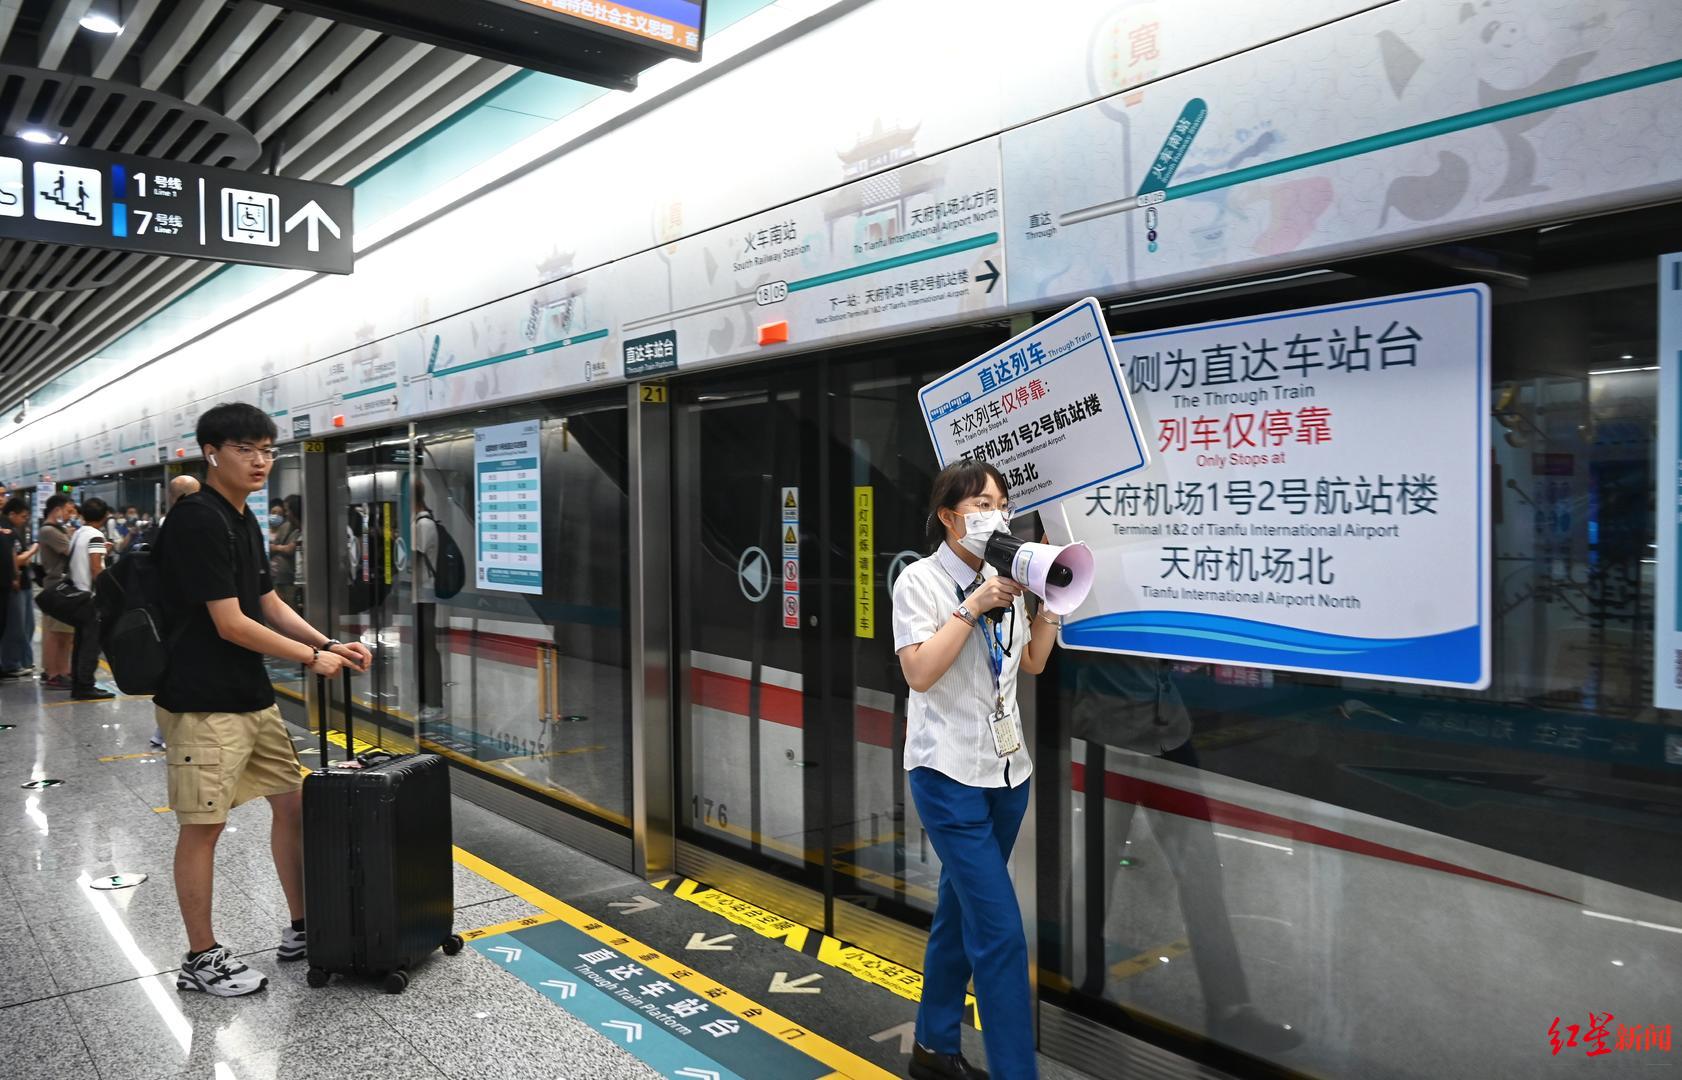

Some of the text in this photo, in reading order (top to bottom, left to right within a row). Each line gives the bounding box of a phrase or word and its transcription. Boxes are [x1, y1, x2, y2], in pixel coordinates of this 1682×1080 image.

[911, 188, 998, 226] 天府机场北方向
[941, 216, 972, 232] Airport
[973, 208, 999, 222] North
[1029, 211, 1051, 229] 直达
[744, 219, 797, 253] 火车南站
[1025, 227, 1057, 240] Through
[733, 244, 810, 272] South Railway Station
[865, 268, 969, 304] 天府机场1号2号航站楼
[625, 339, 674, 364] 直达车站台
[977, 331, 1092, 392] 直达列车 Through Train
[1119, 320, 1423, 395] 侧为直达车站台
[644, 386, 663, 401] 21
[1173, 384, 1315, 409] The Through Train
[960, 393, 1103, 465] 天府机场1号2号航站楼
[965, 431, 977, 442] Train
[976, 427, 988, 439] Only
[988, 421, 1001, 432] Stops
[1158, 405, 1332, 453] 列车仅停靠
[307, 442, 322, 452] 20
[1001, 453, 1017, 467] Tianfu
[1016, 442, 1049, 460] International
[1048, 434, 1067, 447] Airport
[1196, 452, 1286, 470] Only Stops at
[1021, 483, 1039, 496] Airport
[1038, 479, 1053, 490] North
[1085, 473, 1438, 517] 天府机场1号2号航站楼
[1112, 523, 1400, 539] Terminal 1&2 of Tianfu International Airport
[1160, 546, 1335, 586] 天府机场北
[1142, 585, 1361, 609] Tianfu International Airport North
[692, 794, 728, 828] 176
[845, 952, 924, 991] 小心站台
[574, 963, 692, 1036] Through Train Platform
[578, 948, 741, 1038] 直达车站台
